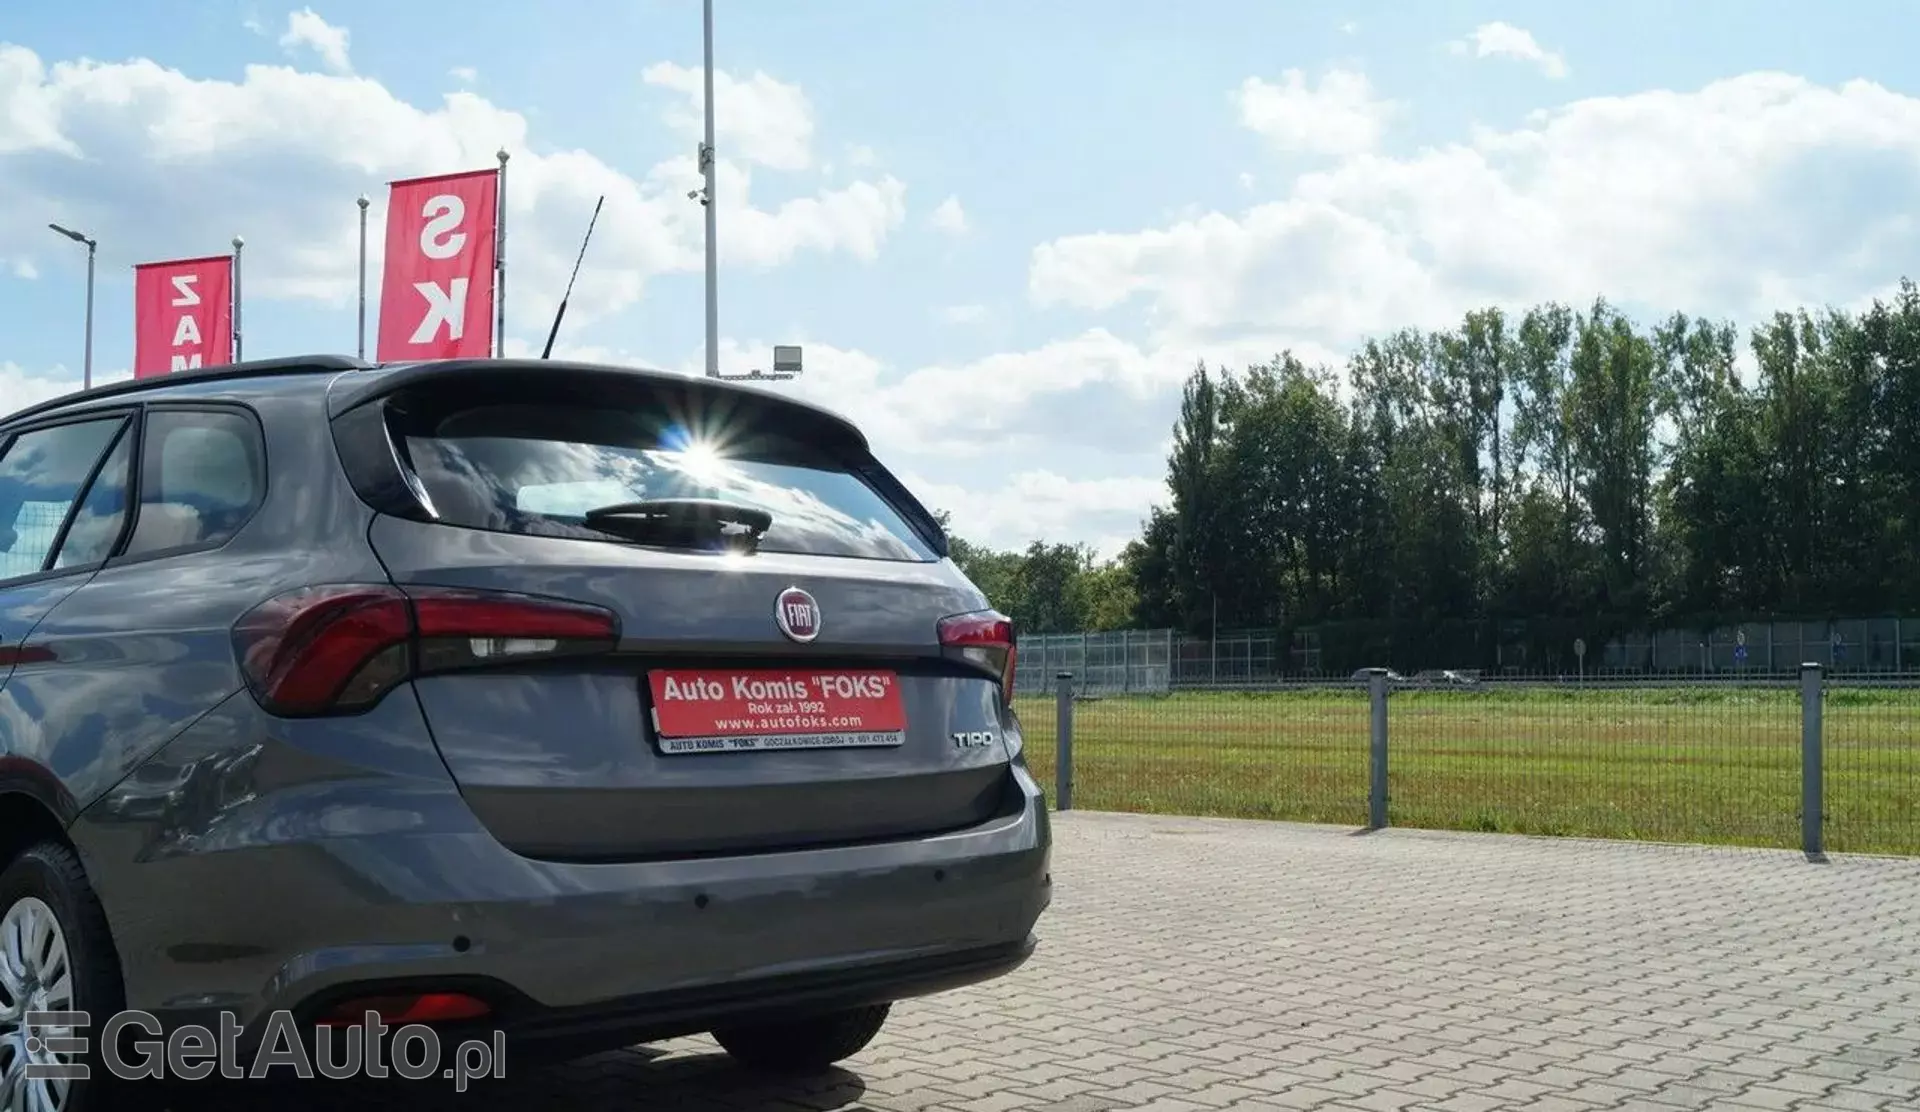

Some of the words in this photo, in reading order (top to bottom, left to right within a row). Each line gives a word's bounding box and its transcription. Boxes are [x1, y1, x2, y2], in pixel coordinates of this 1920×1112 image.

[787, 603, 812, 627] FIAT
[664, 676, 724, 701] Auto
[731, 676, 808, 700] Komis
[811, 675, 891, 699] "FOKS"
[748, 702, 774, 714] Rok
[798, 701, 825, 714] 1992
[715, 715, 862, 730] www.autofoks.com
[670, 740, 694, 750] AUTO
[696, 738, 725, 749] KOMIS
[953, 731, 993, 747] TIPO
